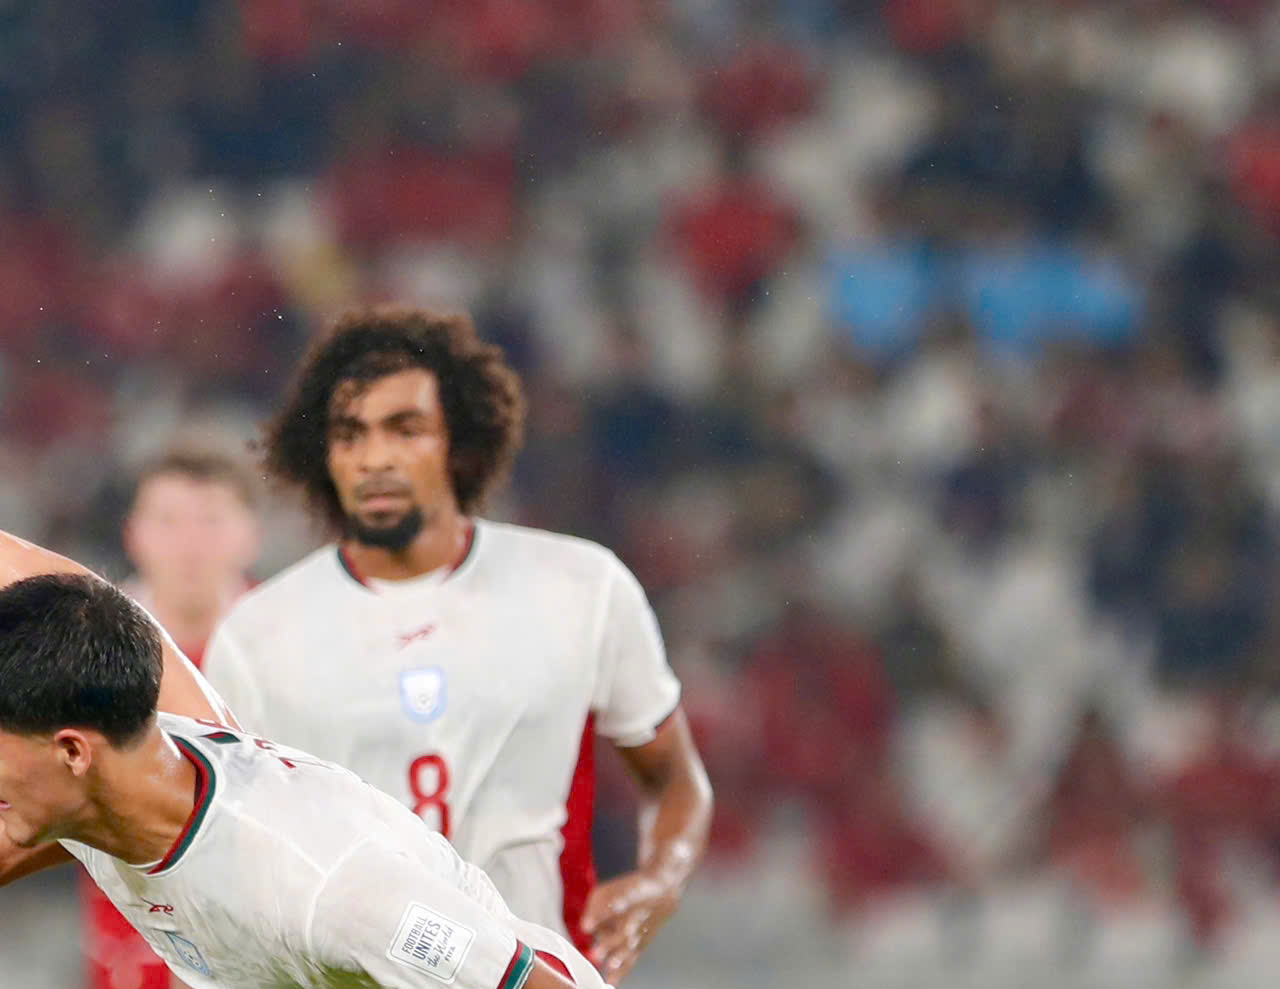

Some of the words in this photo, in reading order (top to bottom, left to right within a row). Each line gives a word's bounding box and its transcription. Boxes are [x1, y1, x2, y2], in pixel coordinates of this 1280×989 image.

[407, 753, 451, 841] 8
[401, 916, 428, 955] FOOTBALL
[412, 920, 441, 960] UNITES
